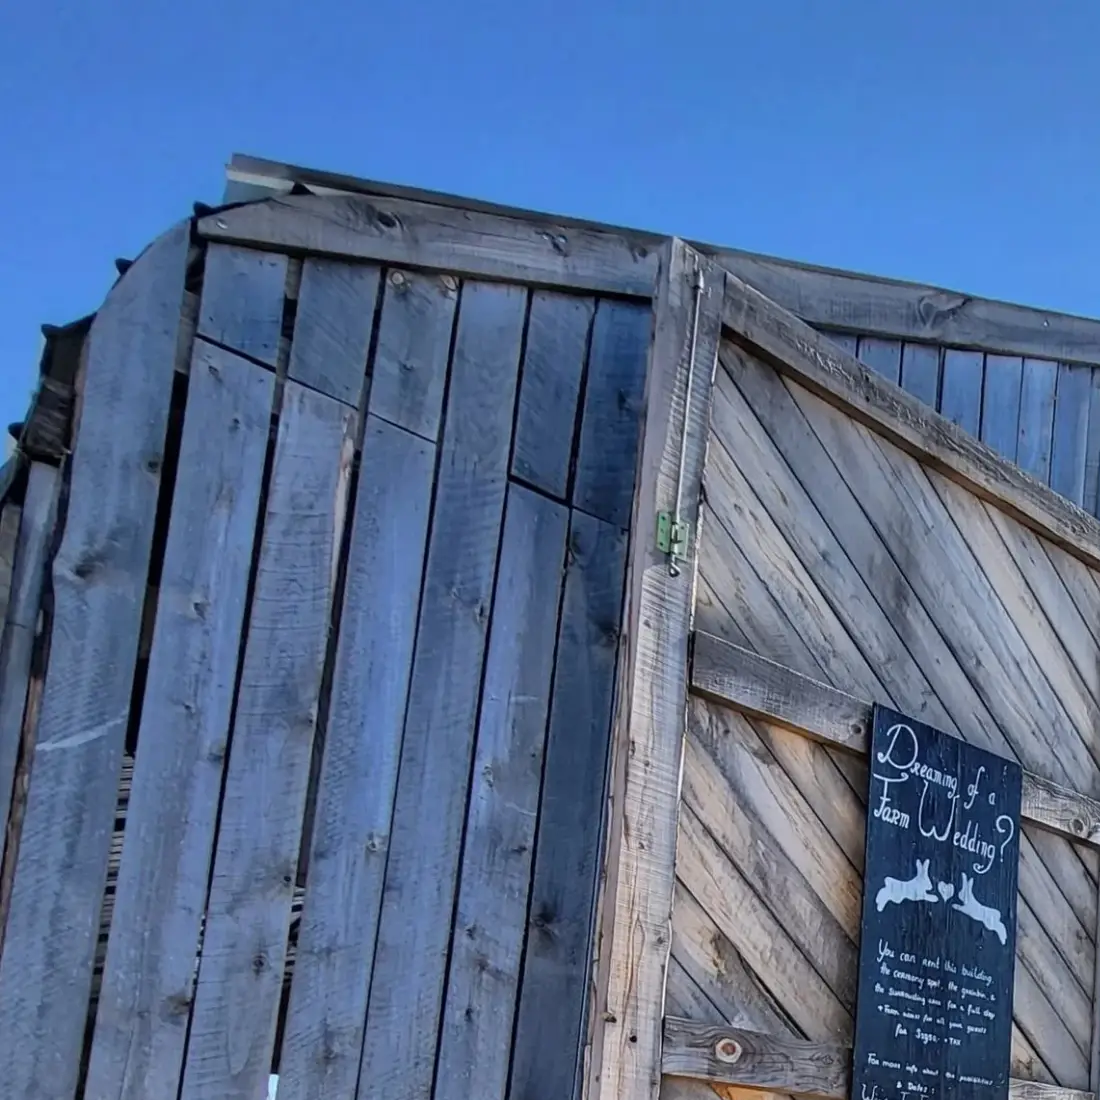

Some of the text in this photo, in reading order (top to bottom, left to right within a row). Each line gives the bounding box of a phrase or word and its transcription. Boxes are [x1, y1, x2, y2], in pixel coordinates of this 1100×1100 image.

[877, 724, 996, 809] Dreaming of a
[873, 772, 910, 829] Farm
[877, 939, 894, 962] You
[900, 953, 915, 963] can
[922, 957, 939, 969] rent
[944, 960, 957, 973] this
[880, 962, 890, 975] the
[948, 981, 958, 992] the
[874, 982, 885, 994] the
[968, 1004, 981, 1016] full
[983, 1010, 995, 1020] day
[895, 1023, 908, 1039] for
[936, 1017, 945, 1026] all
[949, 1021, 963, 1030] your
[967, 1025, 987, 1034] guests
[868, 1053, 879, 1066] For
[882, 1061, 901, 1070] more
[905, 1064, 918, 1074] info
